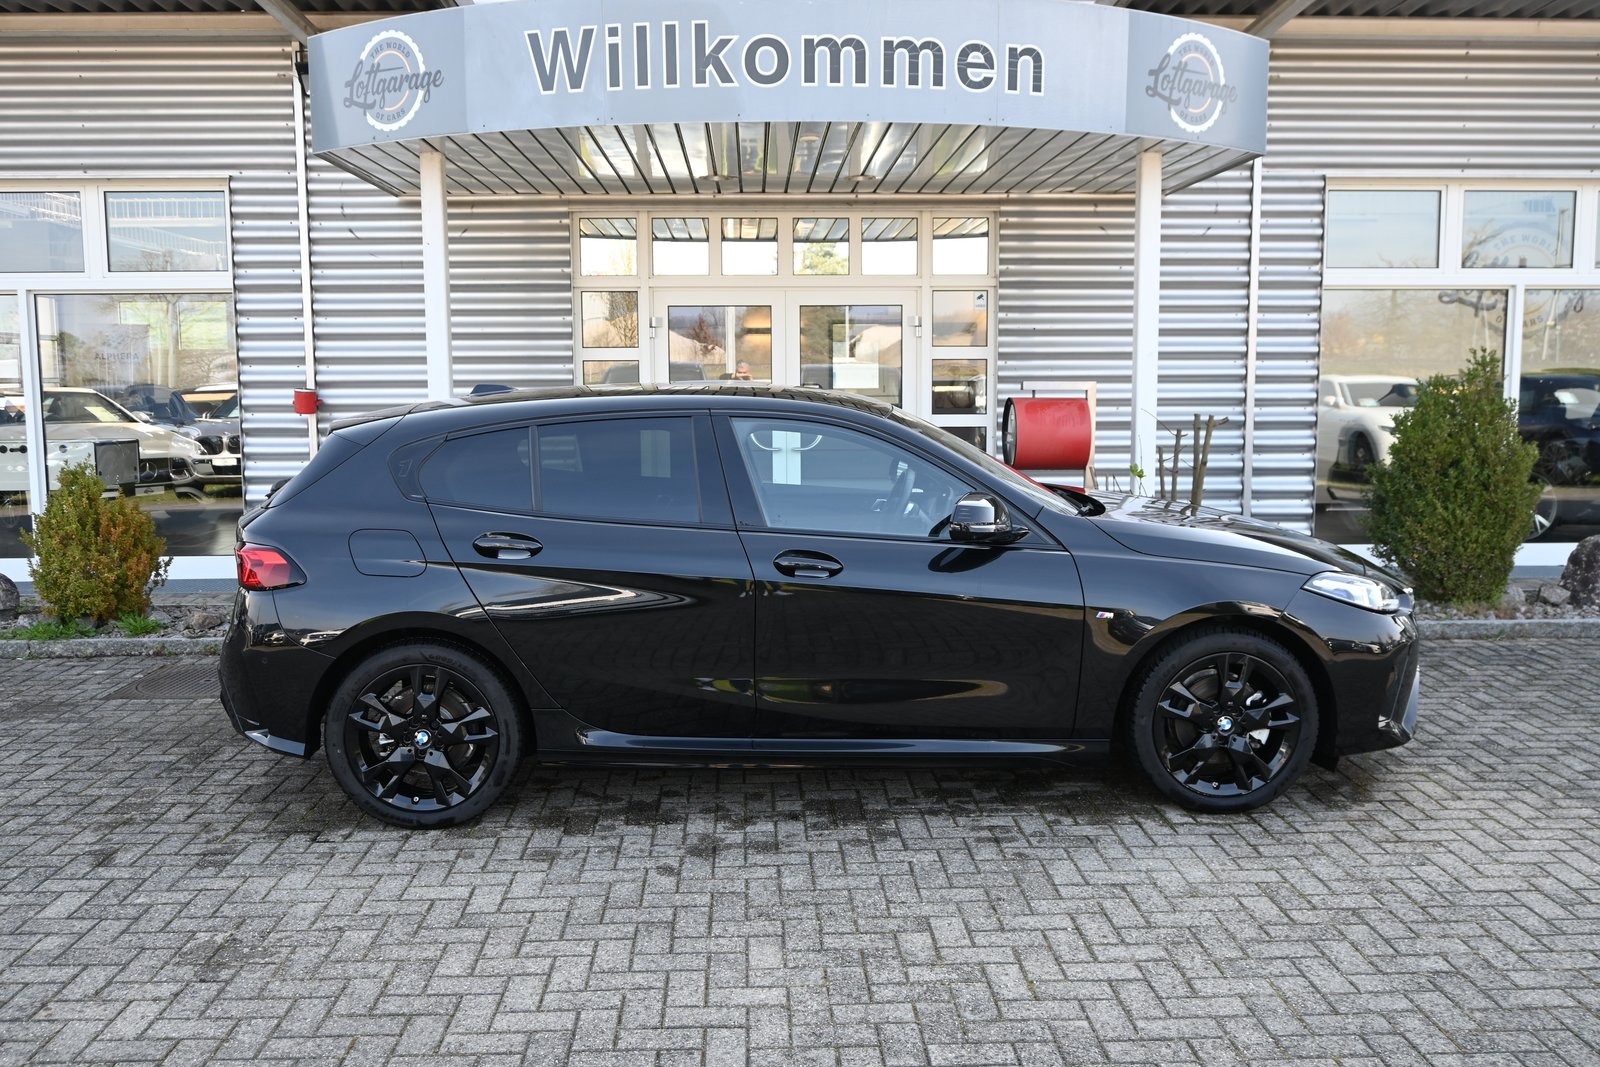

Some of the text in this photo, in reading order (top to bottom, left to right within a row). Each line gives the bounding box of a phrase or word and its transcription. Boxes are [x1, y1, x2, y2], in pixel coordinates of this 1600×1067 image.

[370, 42, 411, 59] THE WORLD
[523, 19, 1044, 96] Willkommen
[344, 59, 444, 116] Loftgarage
[1145, 53, 1238, 115] Loftgarage
[375, 107, 406, 121] OF CARS
[95, 352, 140, 361] ALPHERA
